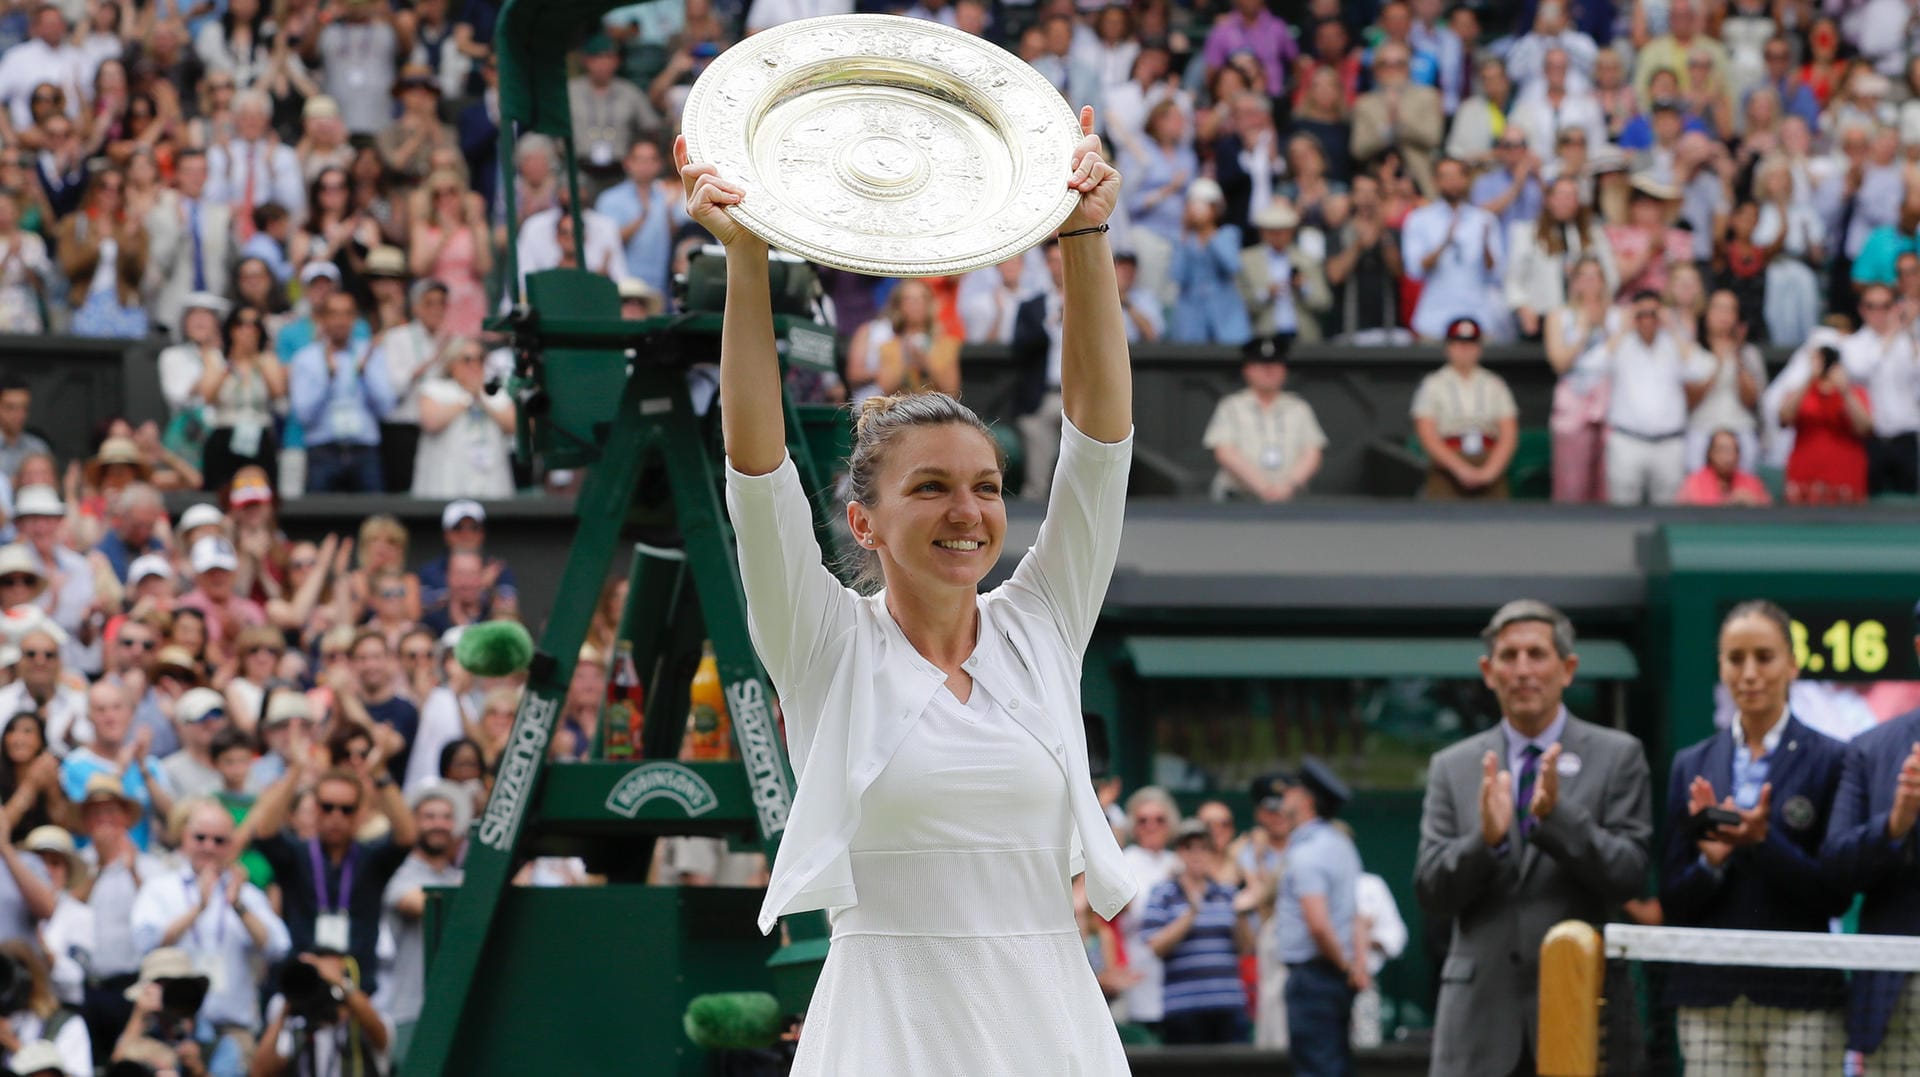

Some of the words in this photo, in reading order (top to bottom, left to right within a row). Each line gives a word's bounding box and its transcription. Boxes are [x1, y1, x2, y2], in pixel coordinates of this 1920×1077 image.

[478, 691, 550, 851] Slazenger
[616, 771, 705, 807] ROBINSONS
[733, 678, 786, 834] Slazenger
